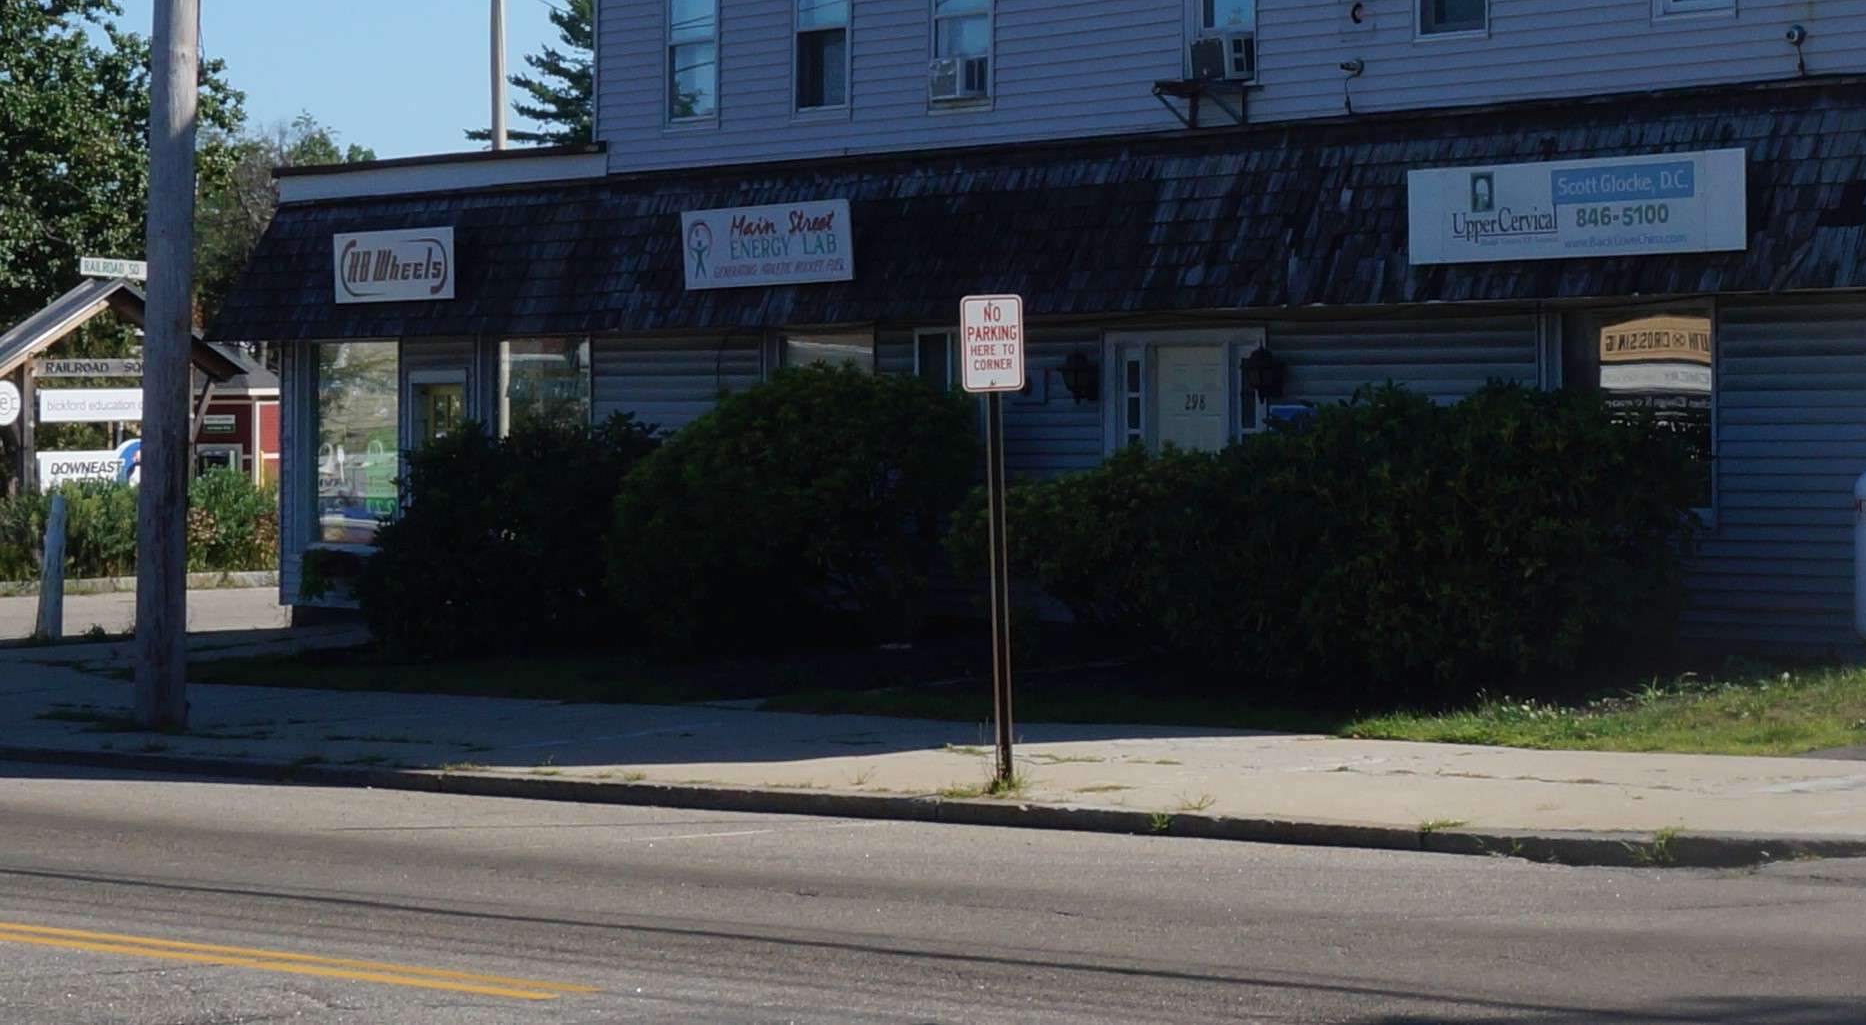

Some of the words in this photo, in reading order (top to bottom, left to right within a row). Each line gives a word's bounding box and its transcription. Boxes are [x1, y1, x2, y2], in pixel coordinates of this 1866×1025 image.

[1557, 175, 1597, 196] Scott
[1659, 170, 1690, 190] D.C.
[729, 214, 777, 236] Main
[788, 208, 835, 234] Street
[1575, 203, 1669, 228] 846-5100
[729, 235, 791, 260] ENERGY
[802, 232, 838, 255] LAB
[83, 259, 125, 276] RAILROAD
[129, 262, 140, 276] SQ
[373, 246, 443, 281] Wheels
[983, 306, 1001, 323] NO
[967, 326, 1018, 343] PARKING
[970, 344, 997, 356] HERE
[1002, 343, 1015, 356] TO
[45, 361, 109, 375] RAILROAD
[973, 358, 1013, 371] CORNER
[47, 399, 87, 413] bickford
[89, 398, 136, 411] education
[1185, 394, 1206, 412] 298
[50, 460, 123, 476] DOWNEAST
